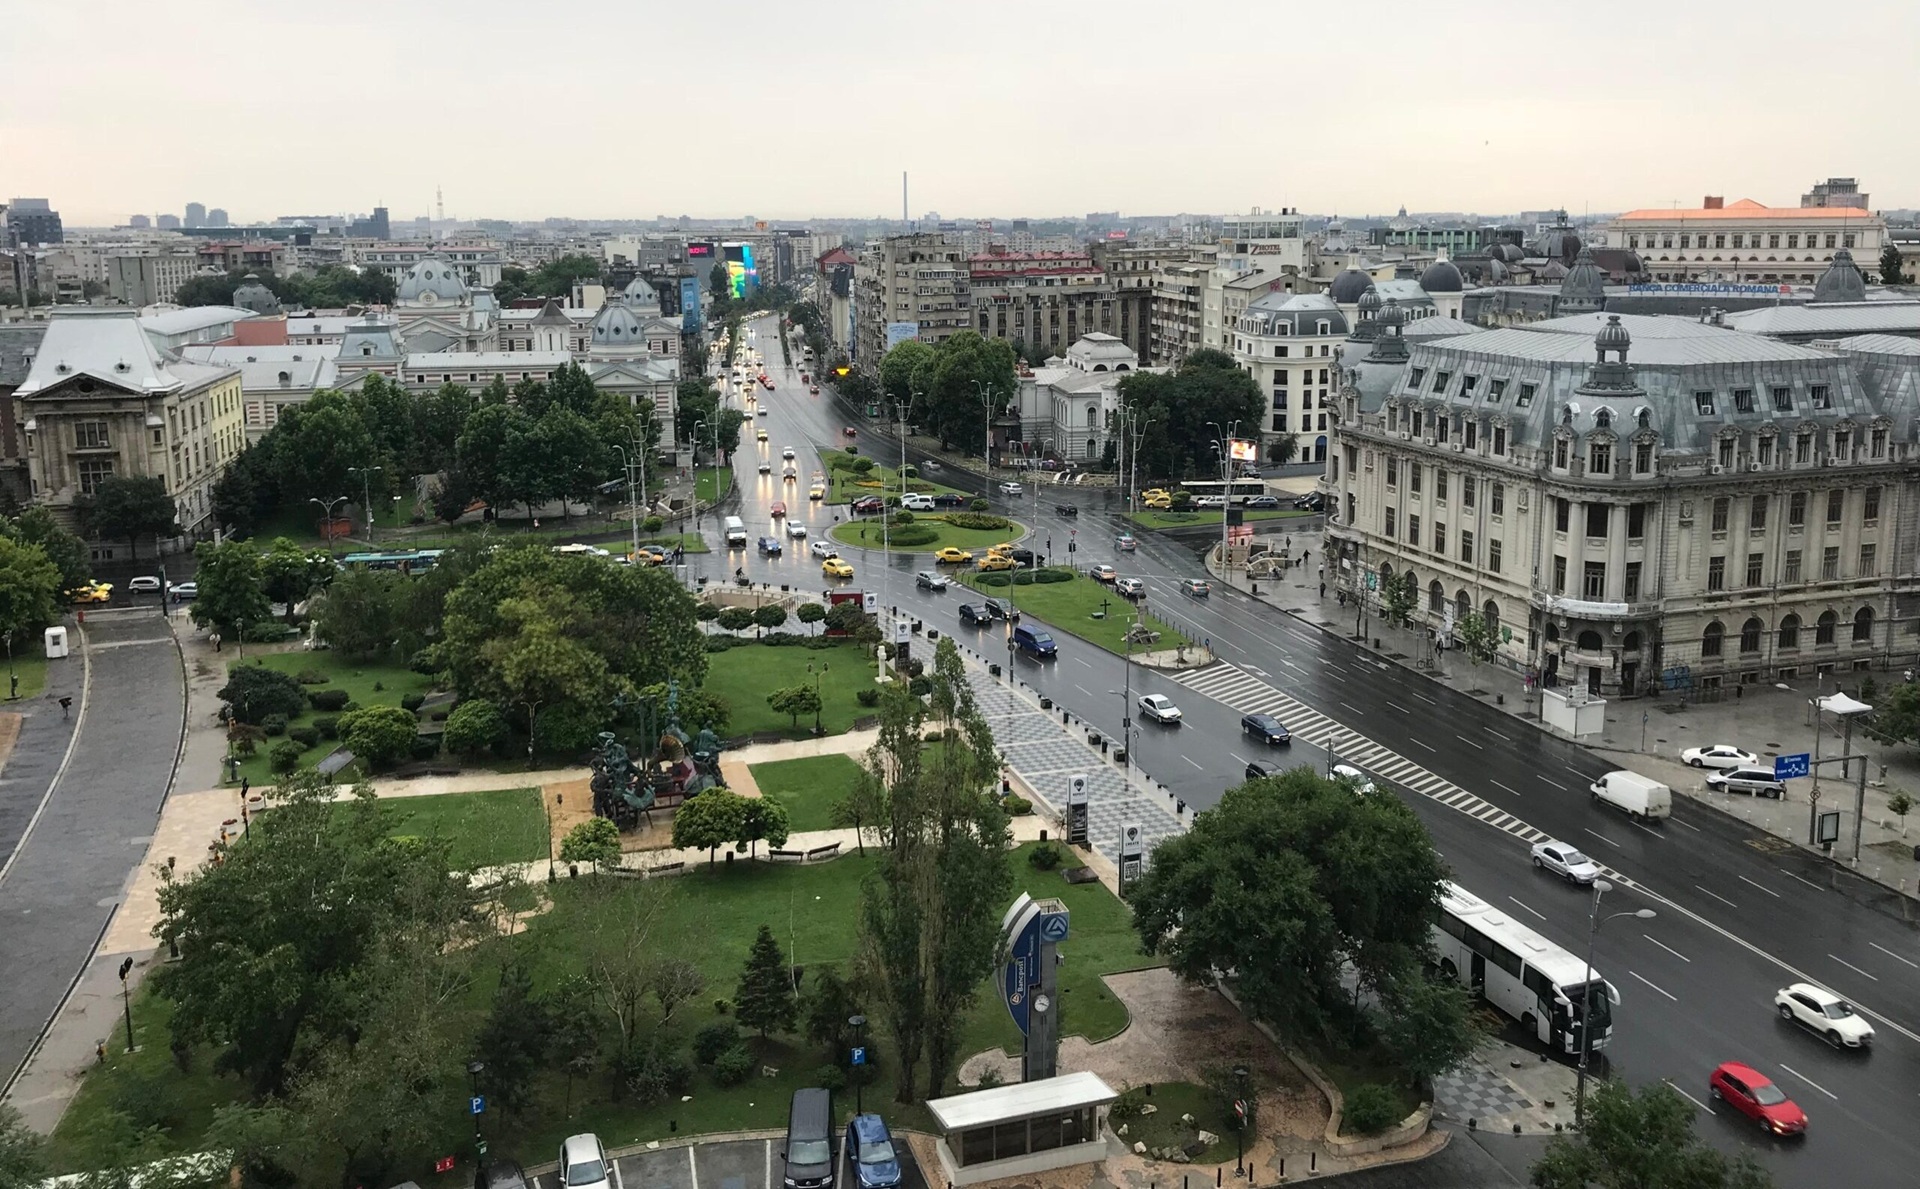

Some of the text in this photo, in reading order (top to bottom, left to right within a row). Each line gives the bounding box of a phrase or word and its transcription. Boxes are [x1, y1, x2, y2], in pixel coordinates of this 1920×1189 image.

[1629, 283, 1663, 292] BANCA
[1017, 960, 1025, 992] Bancpost
[854, 1049, 863, 1060] P
[473, 1097, 481, 1109] P
